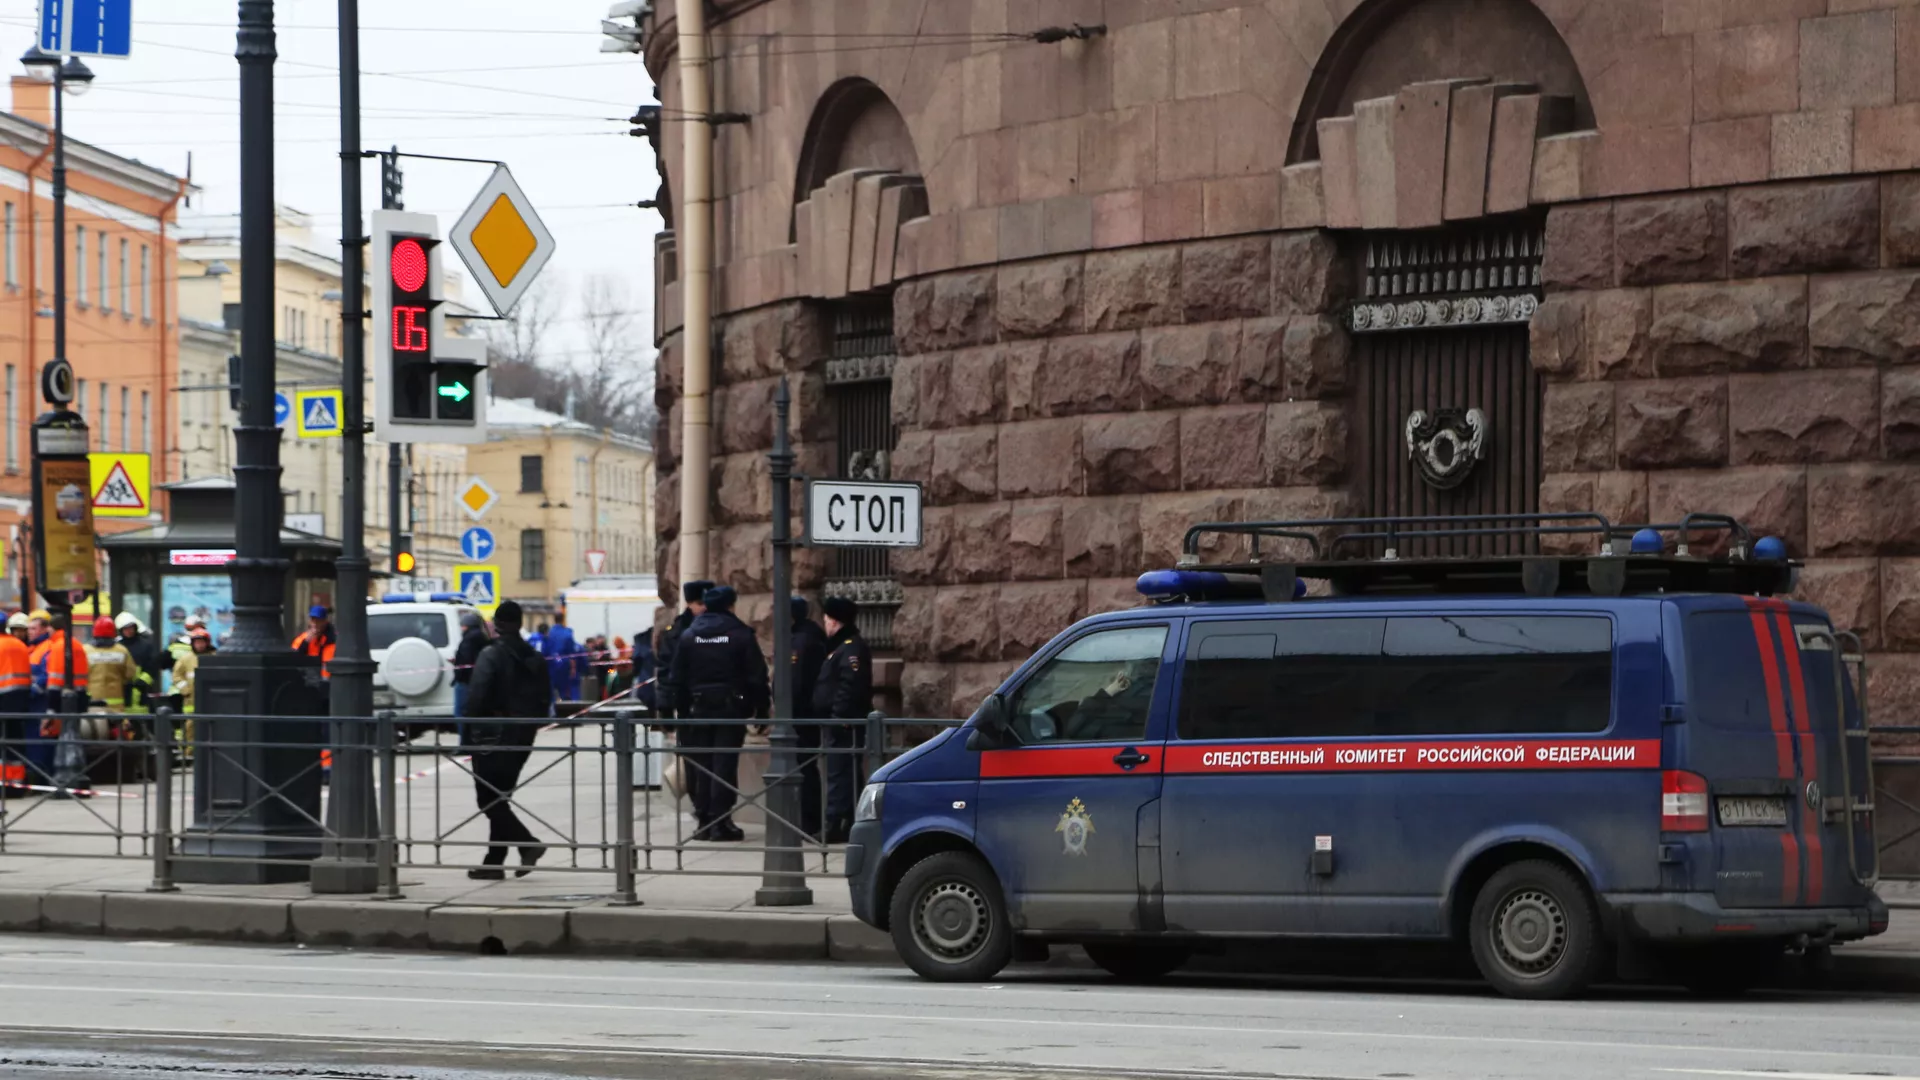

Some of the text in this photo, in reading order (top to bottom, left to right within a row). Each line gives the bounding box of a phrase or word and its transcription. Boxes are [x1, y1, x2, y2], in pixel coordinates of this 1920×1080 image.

[392, 306, 427, 351] 05
[828, 493, 905, 533] СТОП
[1202, 745, 1636, 768] СЛЕДСТВЕННЫЙ КОМИТЕТ РОССИЙСКОЙ ФЕДЕРАЦИИ
